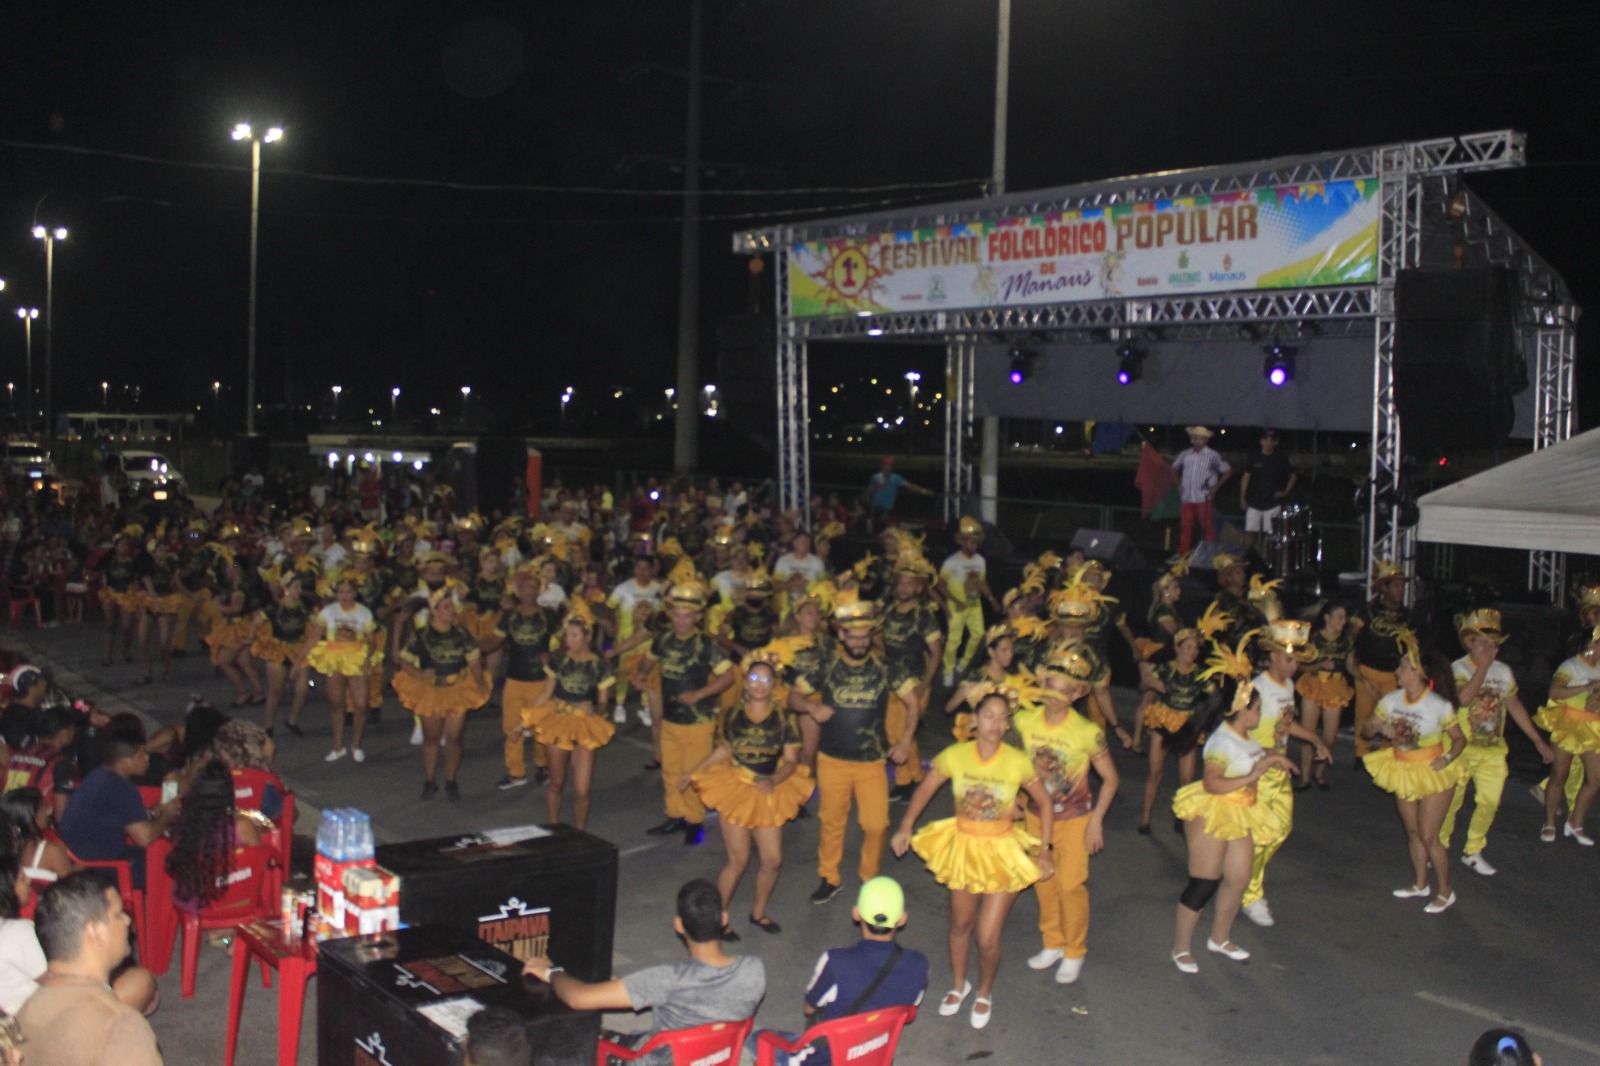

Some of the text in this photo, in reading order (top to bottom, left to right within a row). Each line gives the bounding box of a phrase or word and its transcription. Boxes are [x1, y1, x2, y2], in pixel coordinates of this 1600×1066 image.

[1117, 204, 1257, 252] POPULAR
[1041, 262, 1057, 275] DE
[1001, 270, 1095, 301] Manaus
